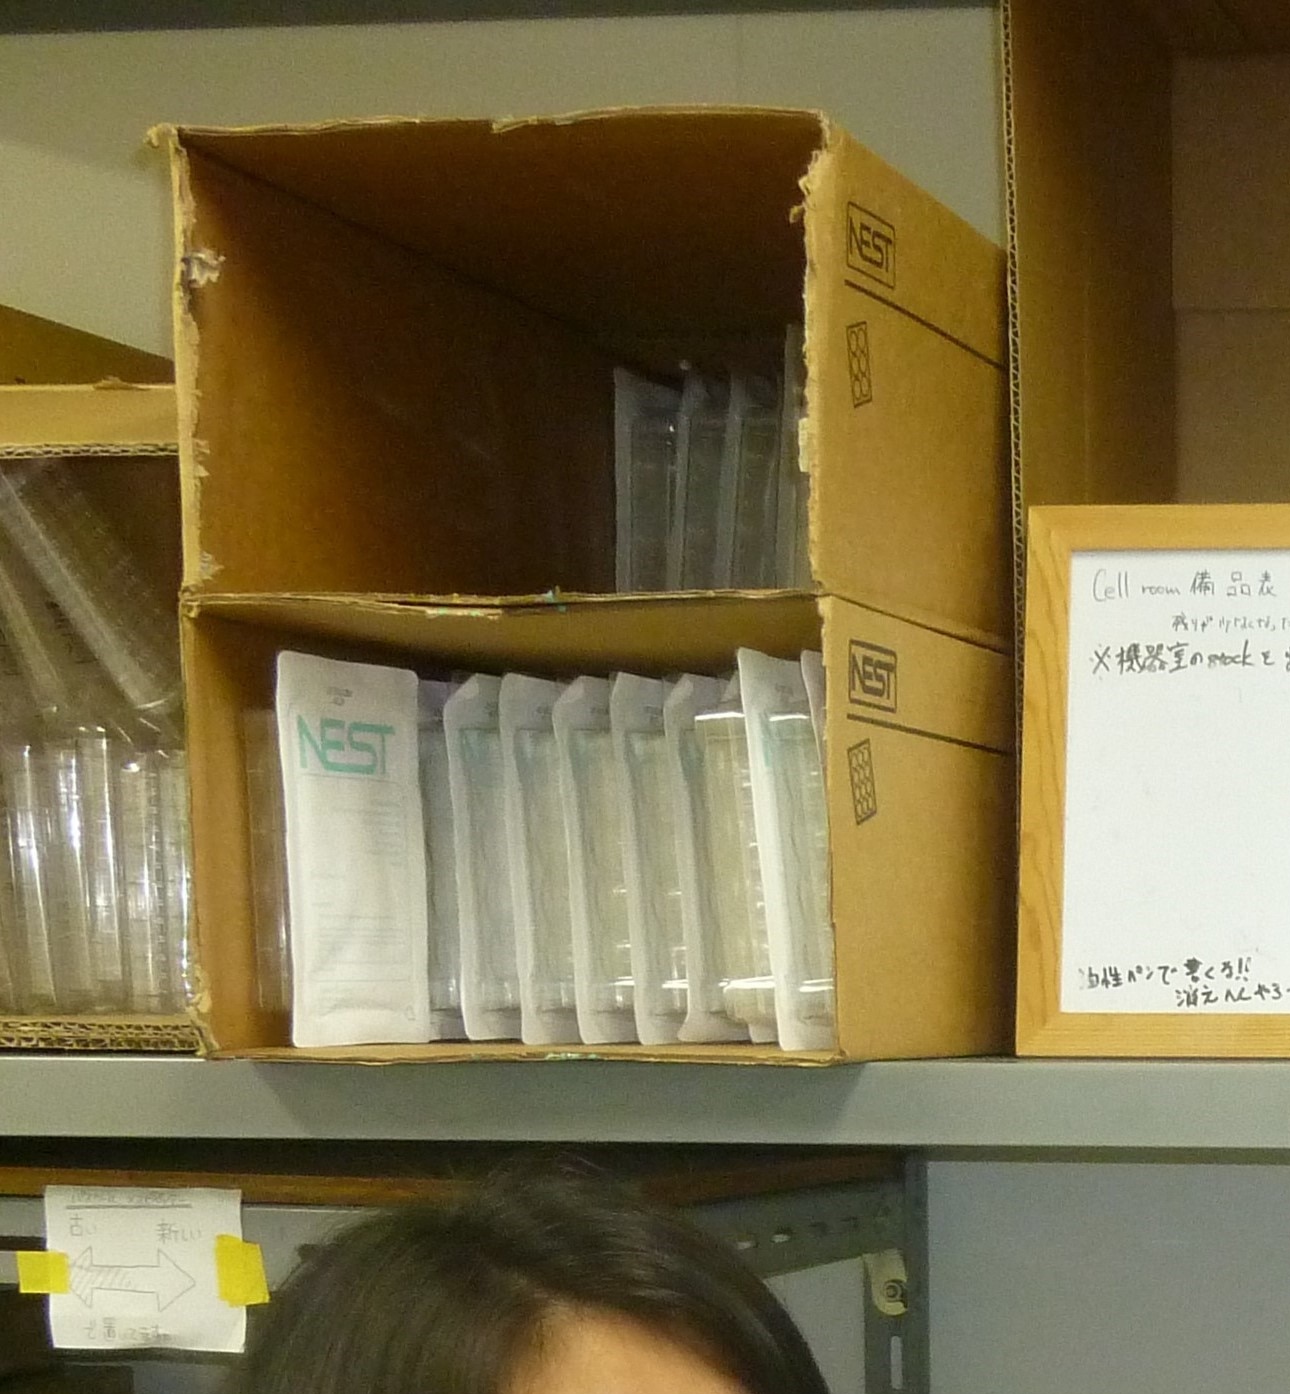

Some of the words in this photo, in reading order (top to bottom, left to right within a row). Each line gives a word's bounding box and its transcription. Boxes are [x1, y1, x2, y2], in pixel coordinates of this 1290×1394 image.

[848, 216, 893, 273] NEST
[1093, 569, 1129, 601] Cell
[1141, 584, 1181, 596] room
[851, 653, 896, 700] NEST
[297, 715, 395, 775] NEST
